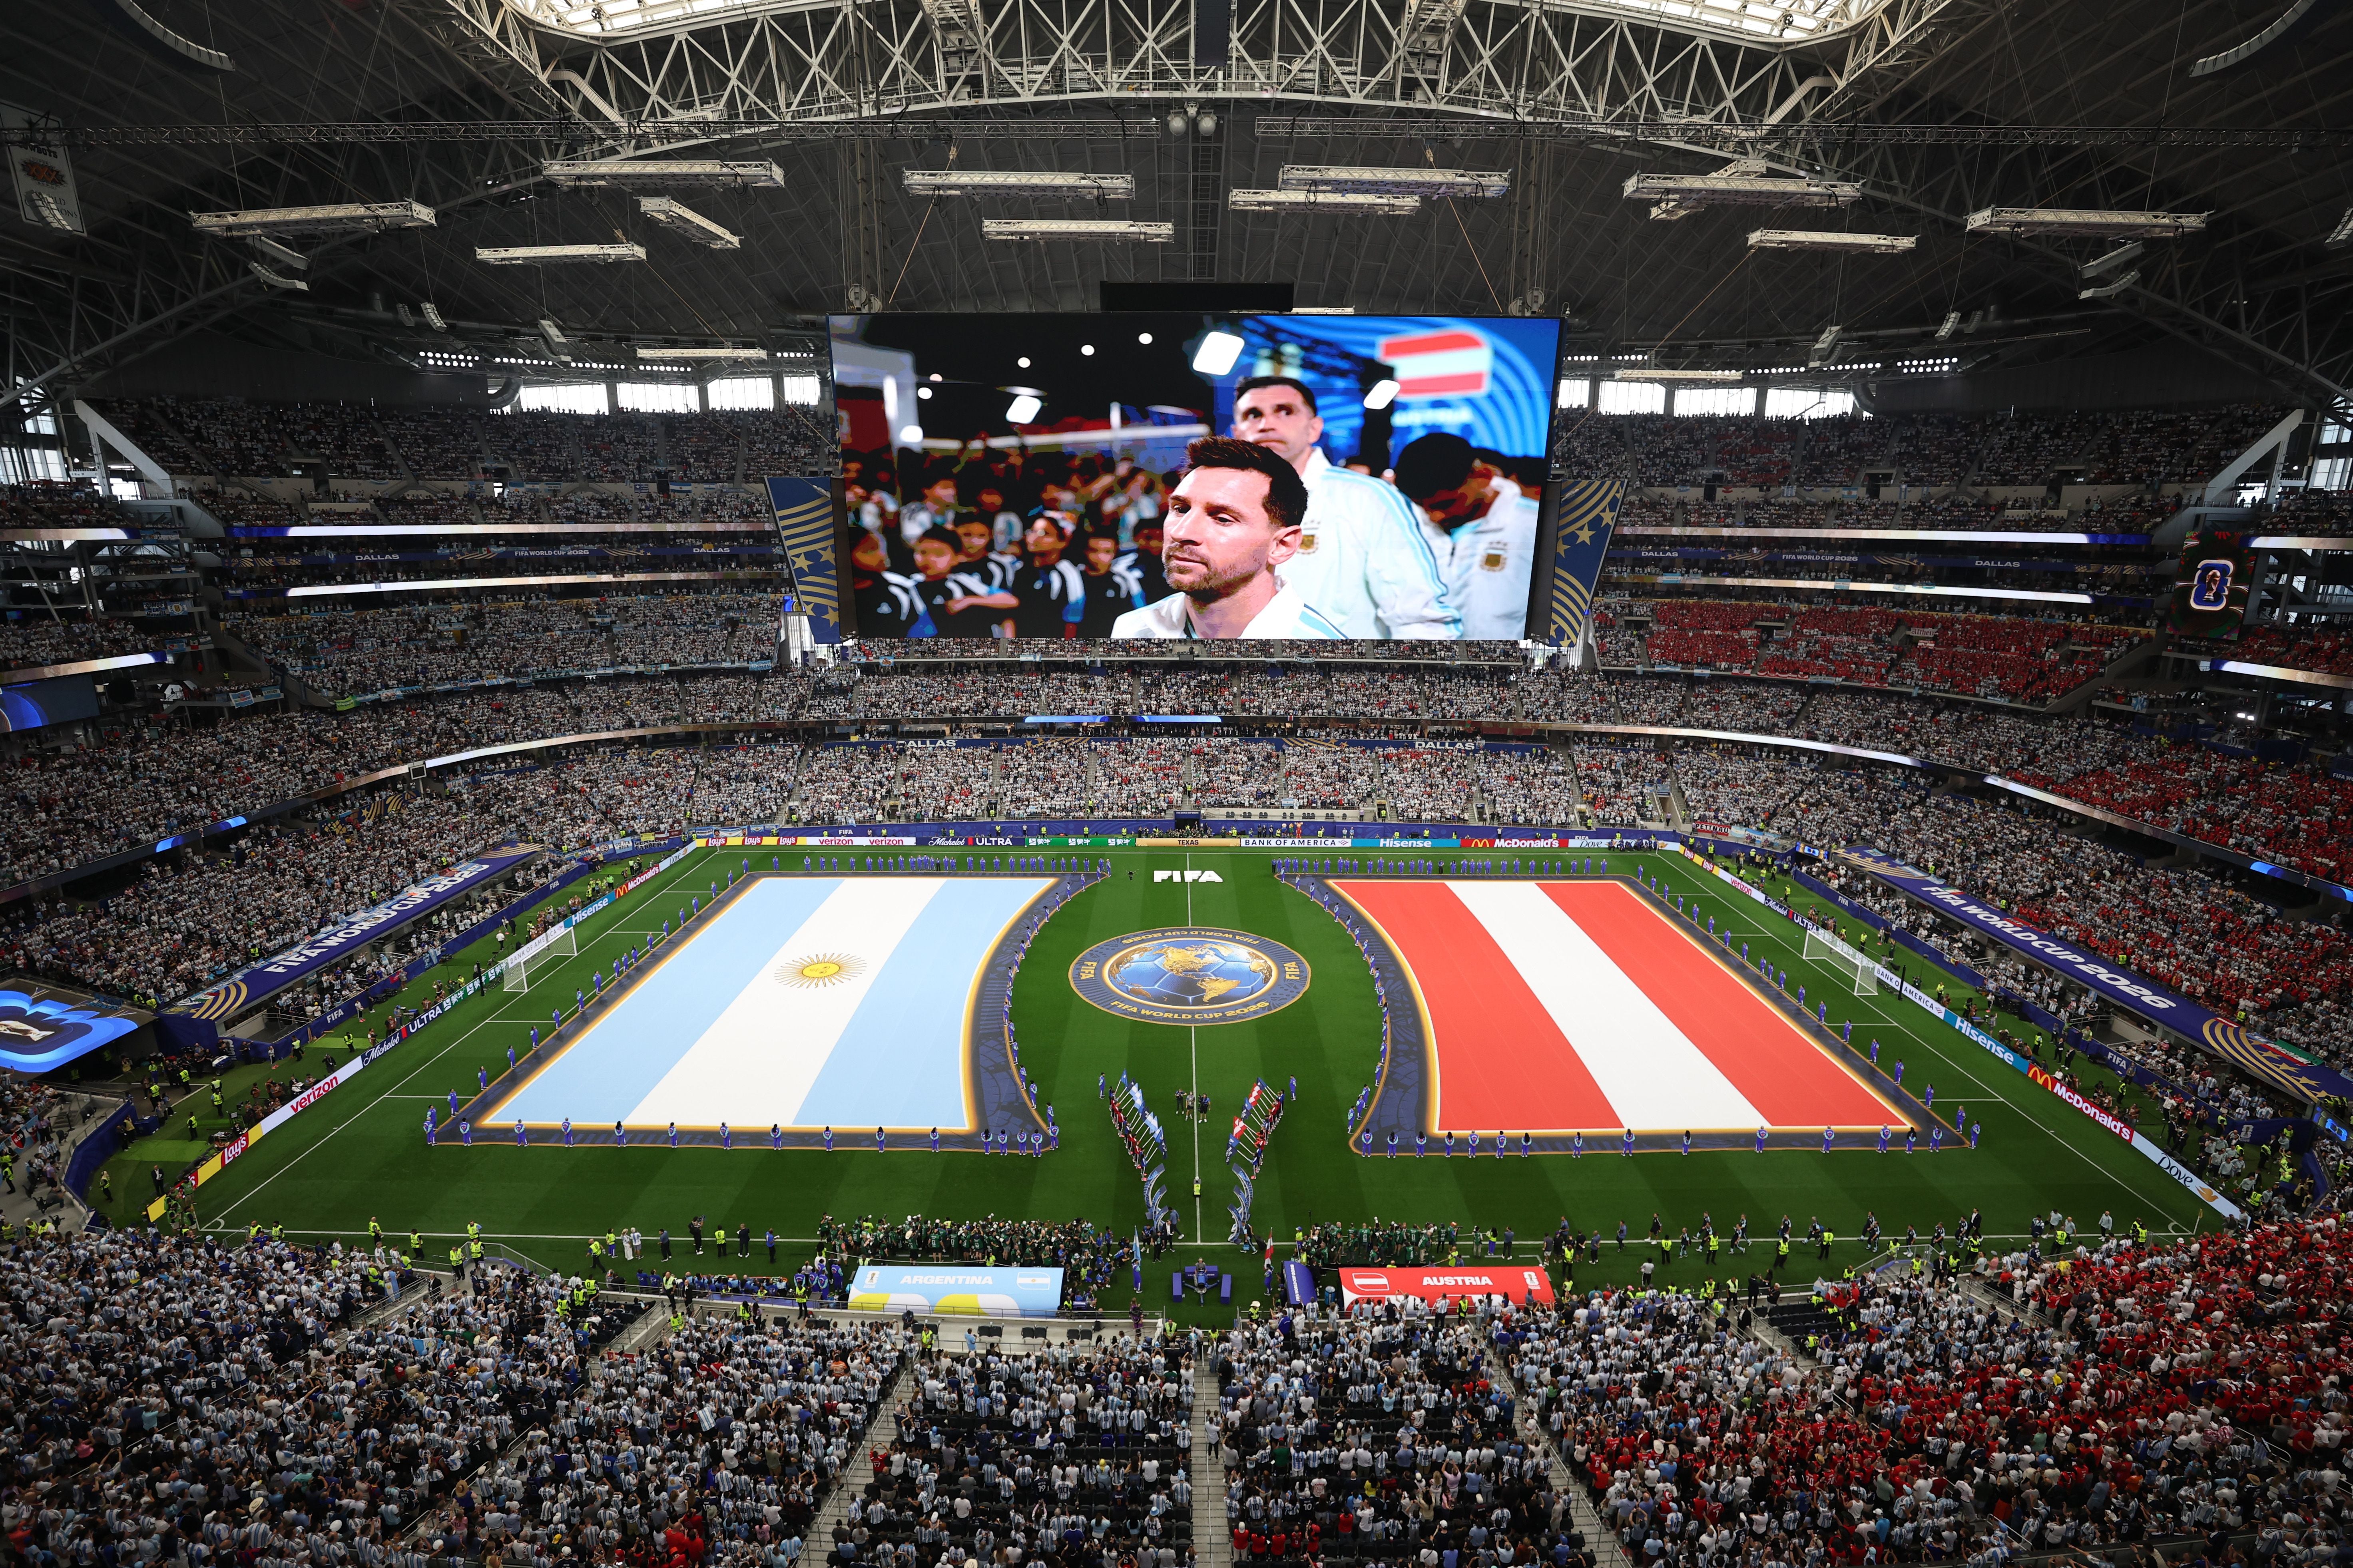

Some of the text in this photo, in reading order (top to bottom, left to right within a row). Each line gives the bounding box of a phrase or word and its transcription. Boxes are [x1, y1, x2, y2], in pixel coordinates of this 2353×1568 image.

[1415, 741, 1475, 750] DALLAS
[1696, 824, 1728, 833] PETTNAU
[709, 838, 726, 846] Lay's
[928, 837, 965, 846] Michelob
[1380, 839, 1432, 848] Hisense
[1494, 839, 1559, 848] McDonald's
[669, 853, 681, 866] Dove
[1685, 848, 1695, 860] Lay's
[1703, 860, 1714, 871] Lay's
[550, 880, 559, 890] FIFA
[628, 866, 659, 890] McDonald's
[1154, 870, 1223, 883] FIFA
[1731, 878, 1752, 895] verizon
[1839, 895, 1848, 906] FIFA
[572, 896, 609, 925] Hisense
[1765, 897, 1817, 932] Michelob ULTRA
[510, 950, 526, 965] BANK
[526, 944, 534, 953] OF
[1922, 886, 2178, 1009] FIFA WORLD CUP 2026
[264, 947, 330, 973] FIFA
[1080, 961, 1098, 980] FIFA
[1286, 961, 1299, 979] FIFA
[1877, 968, 1893, 984] BANK
[1904, 987, 1934, 1011] AMERICA
[327, 1009, 344, 1023] FIFA
[1110, 1001, 1137, 1013] FIFA
[1140, 1010, 1191, 1019] WORLD
[1225, 1002, 1269, 1016] 2026
[363, 1005, 442, 1067] Michelob ULTRA
[1955, 1020, 2014, 1065] Hisense
[2107, 1052, 2126, 1070] FIFA
[290, 1075, 339, 1113] verizon
[2053, 1082, 2132, 1141] McDonald's
[14, 1133, 24, 1142] NOB
[224, 1136, 248, 1164] Lay's
[2158, 1152, 2193, 1188] Dove
[900, 1275, 993, 1284] ARGENTINA
[1423, 1276, 1493, 1285] AUSTRIA
[1806, 1476, 1813, 1486] 20
